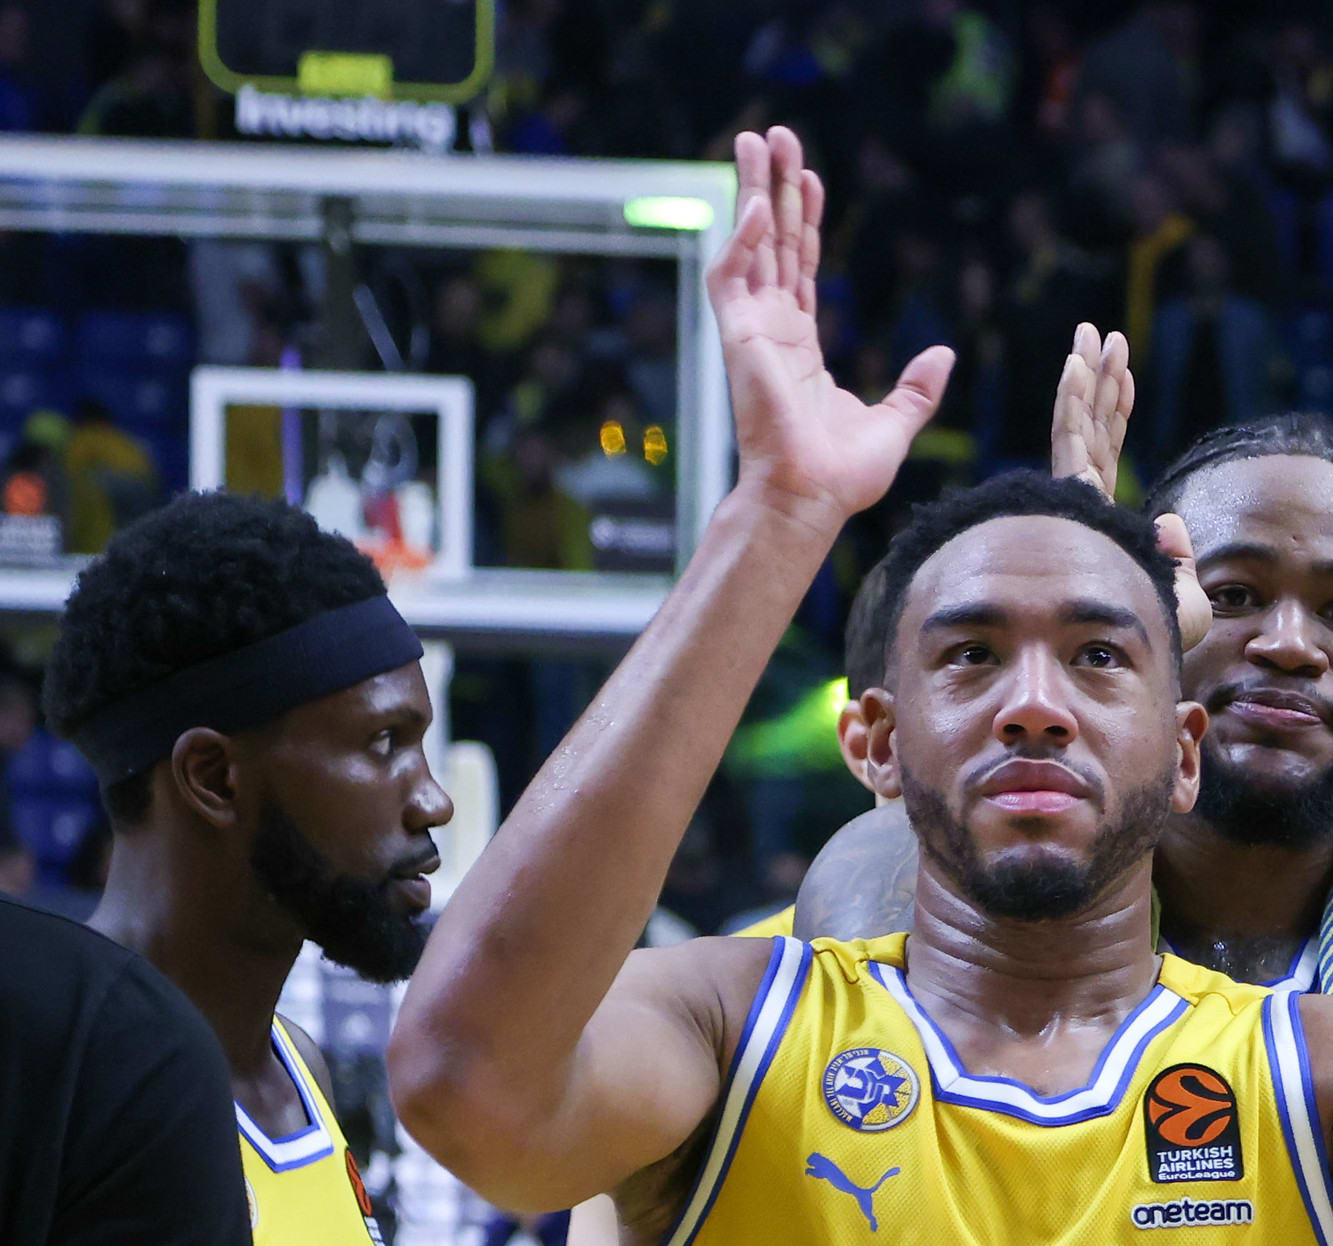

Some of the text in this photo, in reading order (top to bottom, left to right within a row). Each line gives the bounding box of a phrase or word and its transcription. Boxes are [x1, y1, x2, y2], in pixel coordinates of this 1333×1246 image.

[1157, 1145, 1233, 1163] TURKISH
[1158, 1157, 1235, 1173] AIRLINES
[1158, 1170, 1236, 1181] EuroLeague
[1133, 1200, 1252, 1226] oneteam
